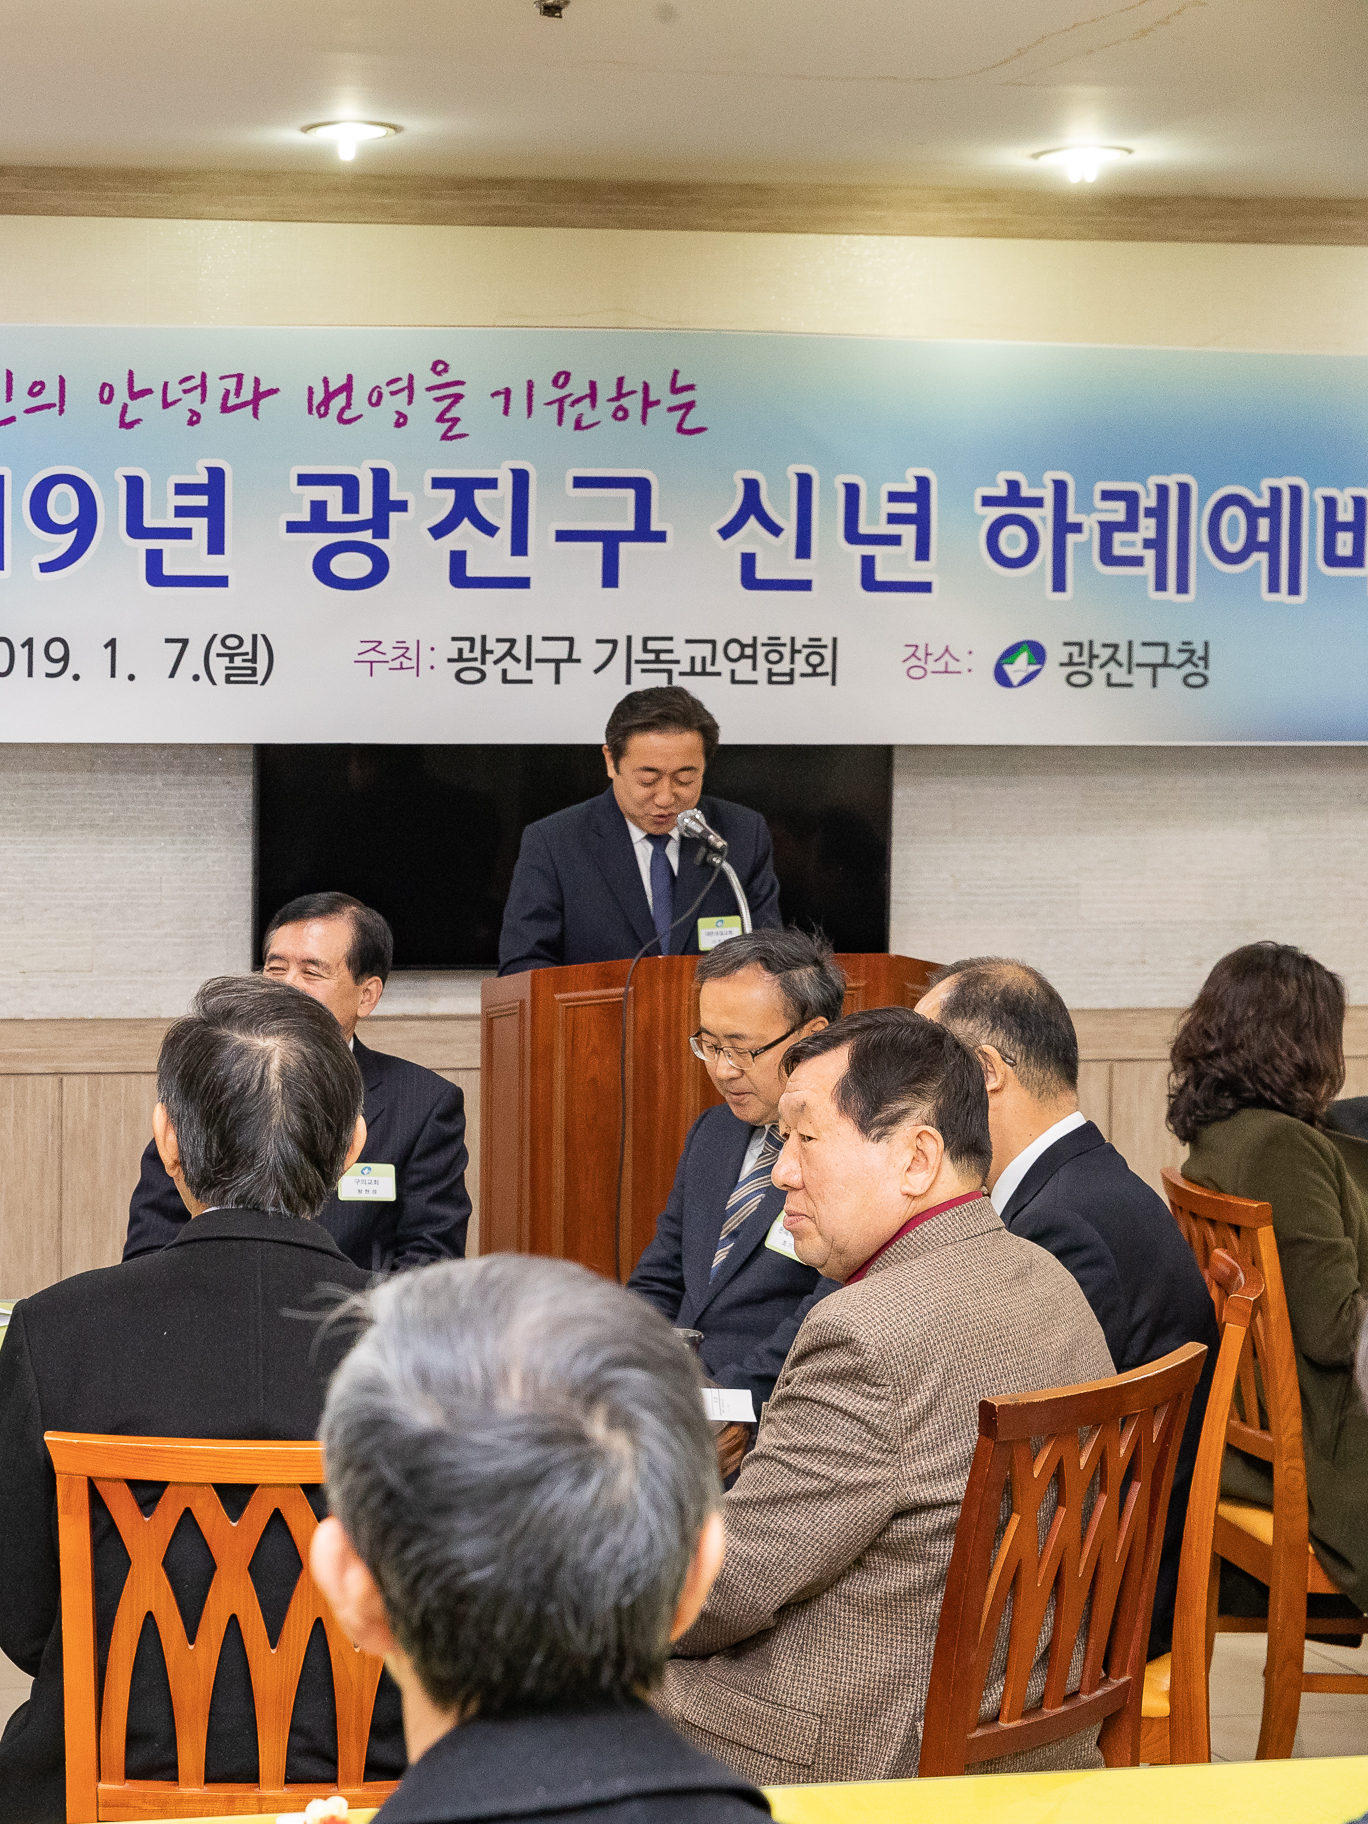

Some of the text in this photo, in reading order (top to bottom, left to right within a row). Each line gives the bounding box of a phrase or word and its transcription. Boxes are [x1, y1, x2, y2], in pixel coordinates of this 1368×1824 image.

[98, 369, 280, 430] 안녕과
[307, 359, 468, 441] 번영을
[491, 369, 707, 436] 기원하는
[285, 466, 668, 592] 광진구
[717, 470, 933, 593] 신년
[103, 637, 136, 682] 1.
[164, 633, 275, 687] 7.(월)
[353, 634, 838, 686] 주최: 광진구 기독교연합회
[903, 639, 1210, 690] 장소: 광진구청
